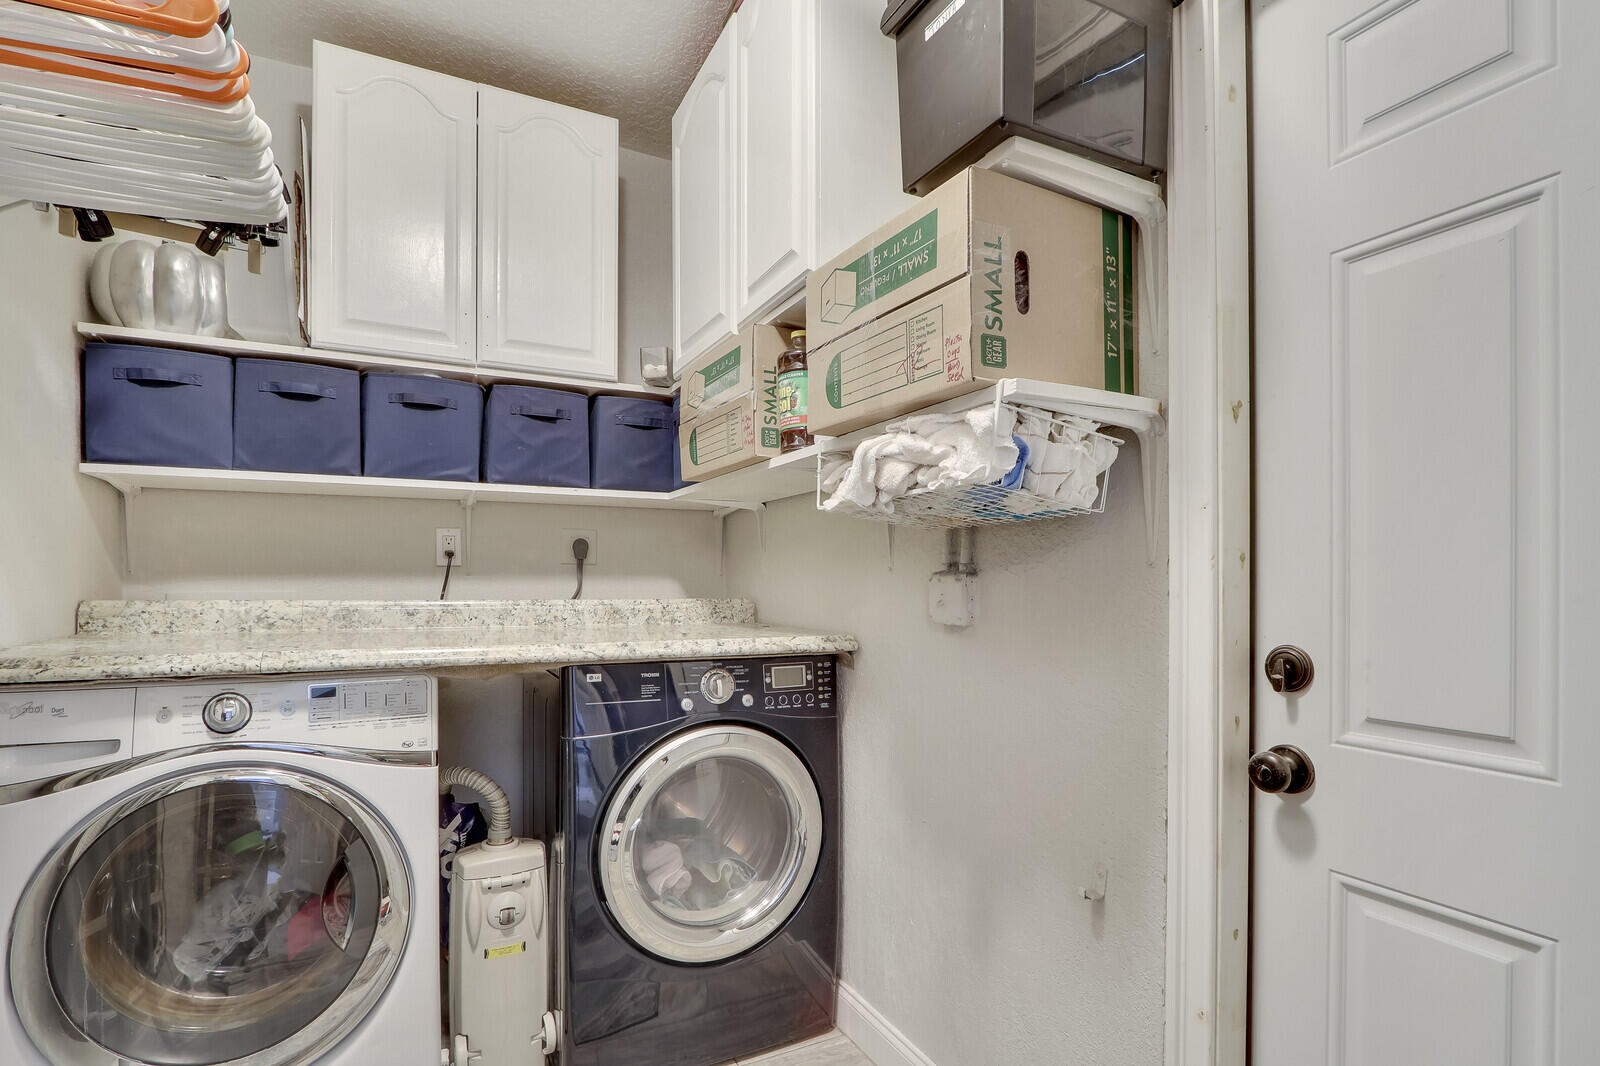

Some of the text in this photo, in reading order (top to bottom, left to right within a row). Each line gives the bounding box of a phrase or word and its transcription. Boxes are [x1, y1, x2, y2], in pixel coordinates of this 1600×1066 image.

[909, 228, 922, 247] 17"
[897, 249, 929, 277] SMALL
[984, 236, 1003, 332] SMALL
[1105, 247, 1118, 358] 17" x 11" x 13"
[992, 340, 1003, 363] GEAR
[763, 366, 778, 426] SMALL
